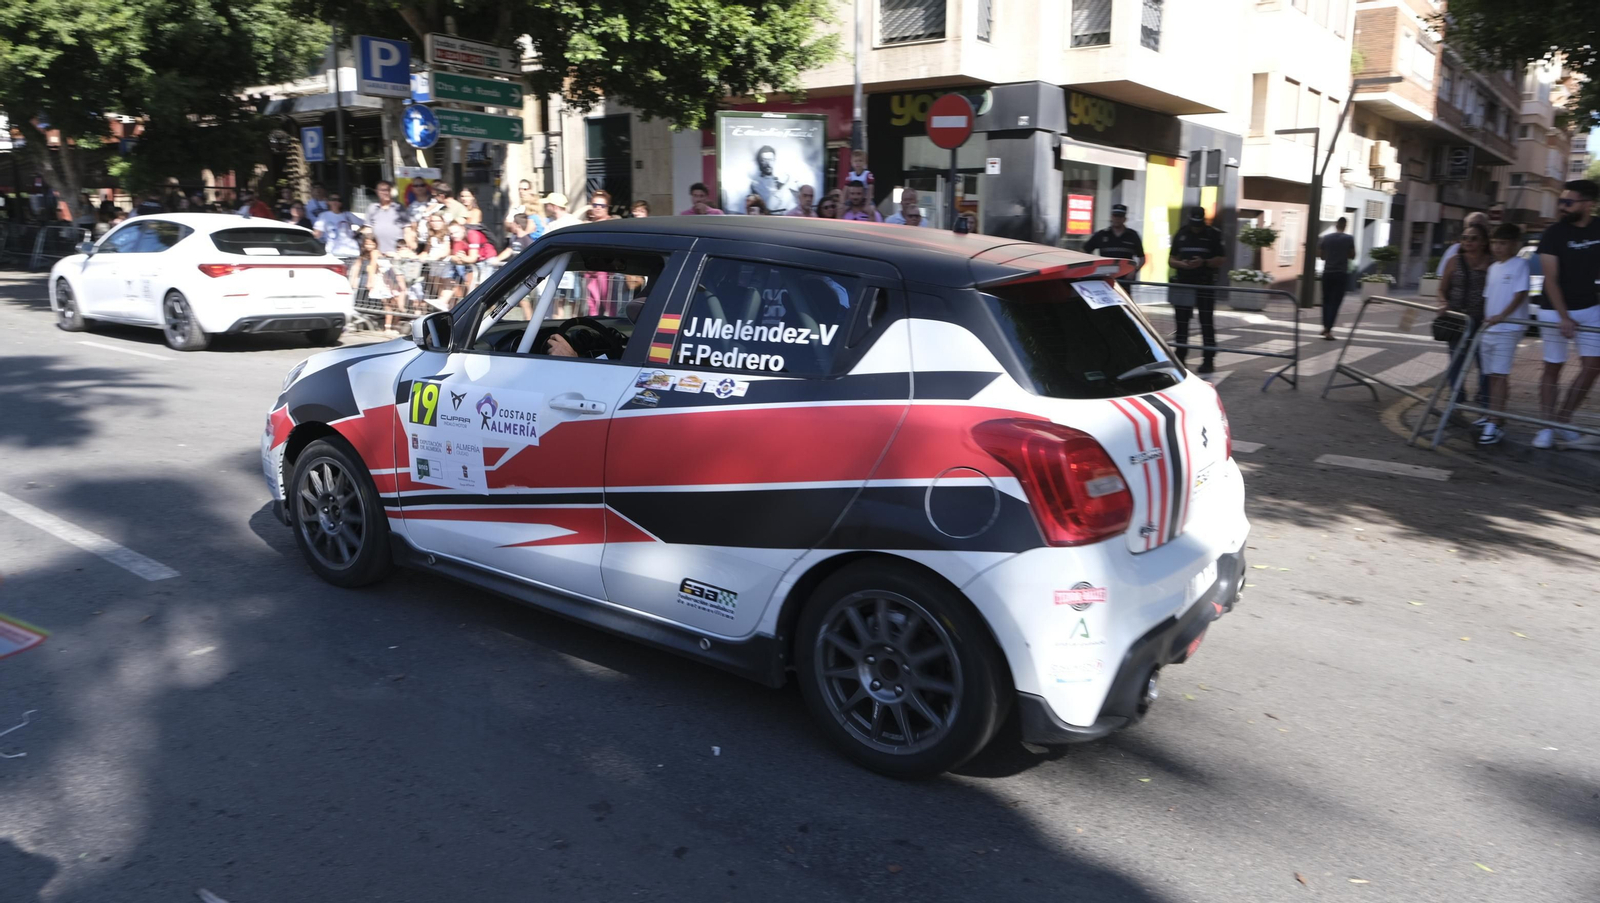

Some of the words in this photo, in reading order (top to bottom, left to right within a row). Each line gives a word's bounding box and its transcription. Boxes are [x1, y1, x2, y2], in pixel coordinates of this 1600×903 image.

[370, 41, 401, 78] P
[461, 85, 473, 94] de
[305, 130, 320, 157] P
[683, 317, 839, 346] J.Meléndez-V
[678, 343, 785, 372] F.Pedrero
[412, 382, 439, 425] 19
[440, 414, 471, 424] CUPRA
[499, 408, 525, 420] COSTA
[526, 412, 537, 422] DE
[491, 420, 537, 438] ALMERÍA
[456, 443, 480, 453] ALMERÍA
